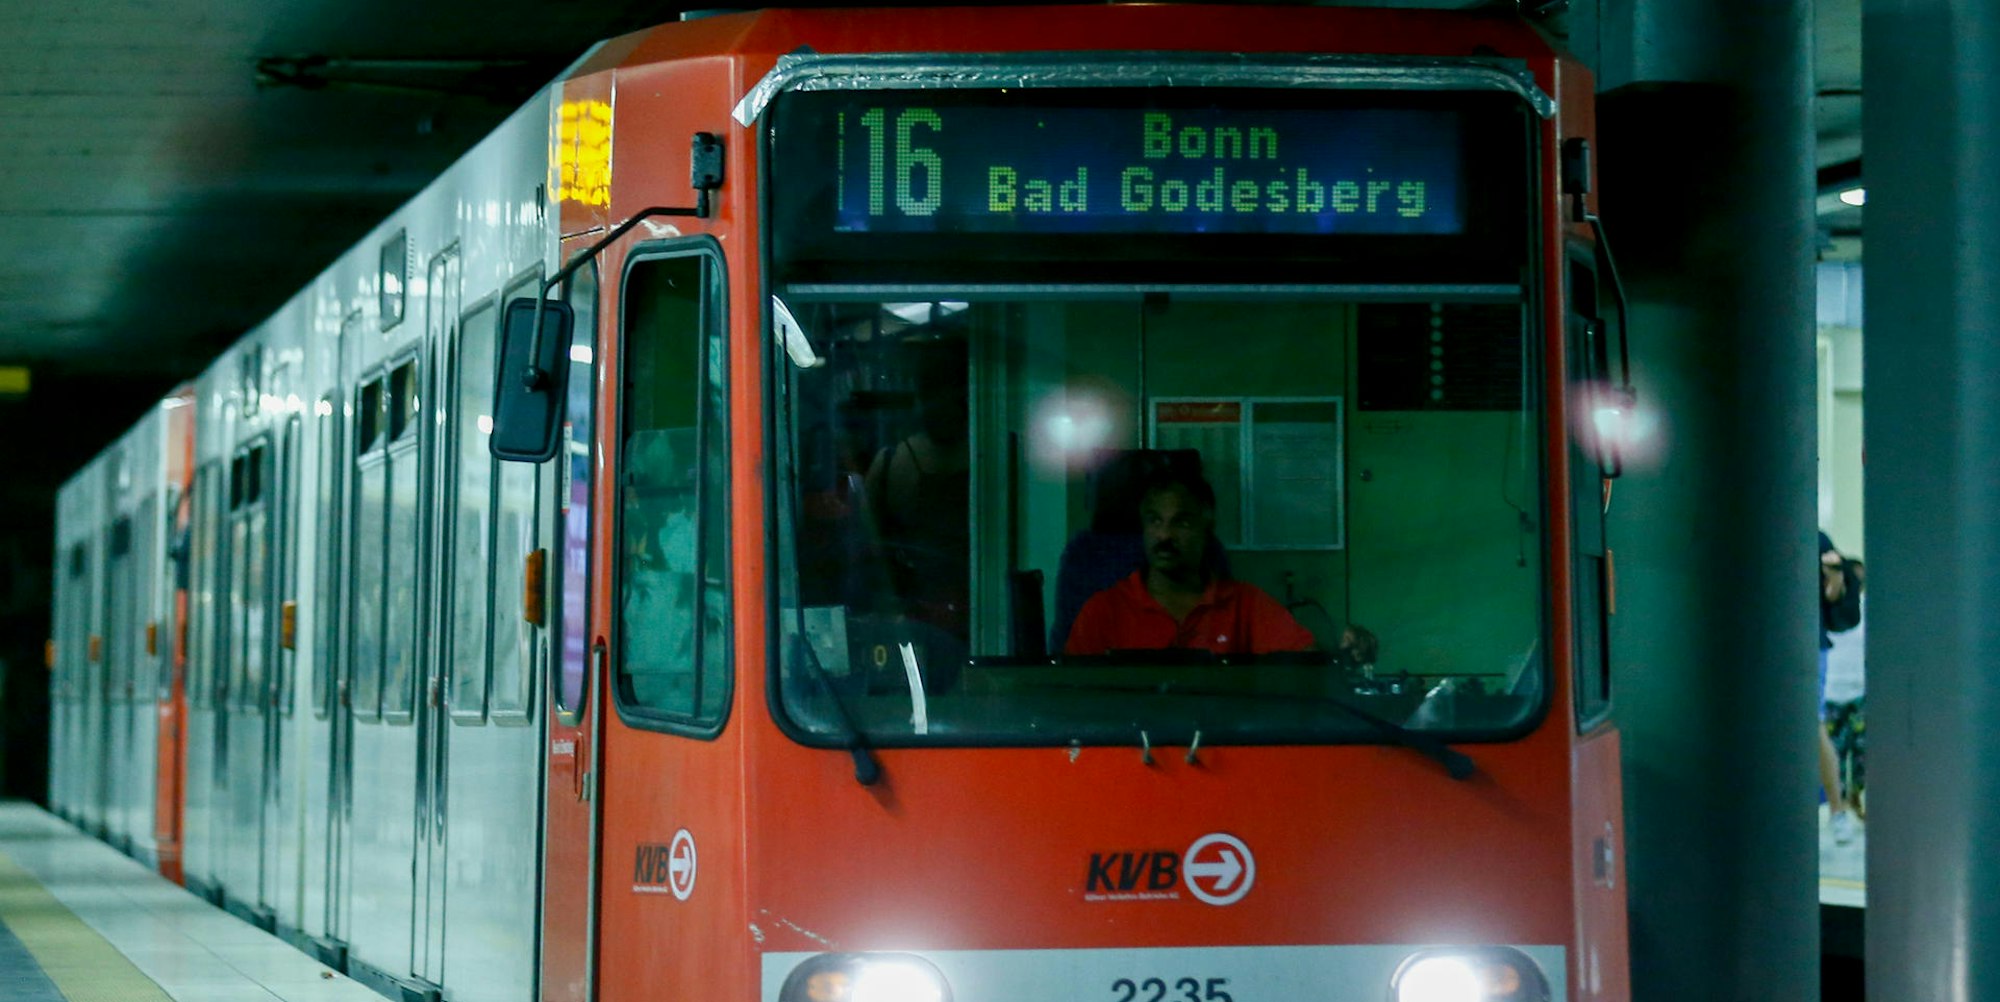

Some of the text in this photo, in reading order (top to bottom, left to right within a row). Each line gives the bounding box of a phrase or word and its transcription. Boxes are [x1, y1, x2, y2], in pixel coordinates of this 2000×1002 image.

[1143, 112, 1279, 159] Bonn
[861, 108, 942, 216] 16
[988, 166, 1426, 218] Bad Godesberg
[634, 846, 669, 884] KVB
[1086, 851, 1180, 892] KVB
[1111, 977, 1234, 1002] 2235
